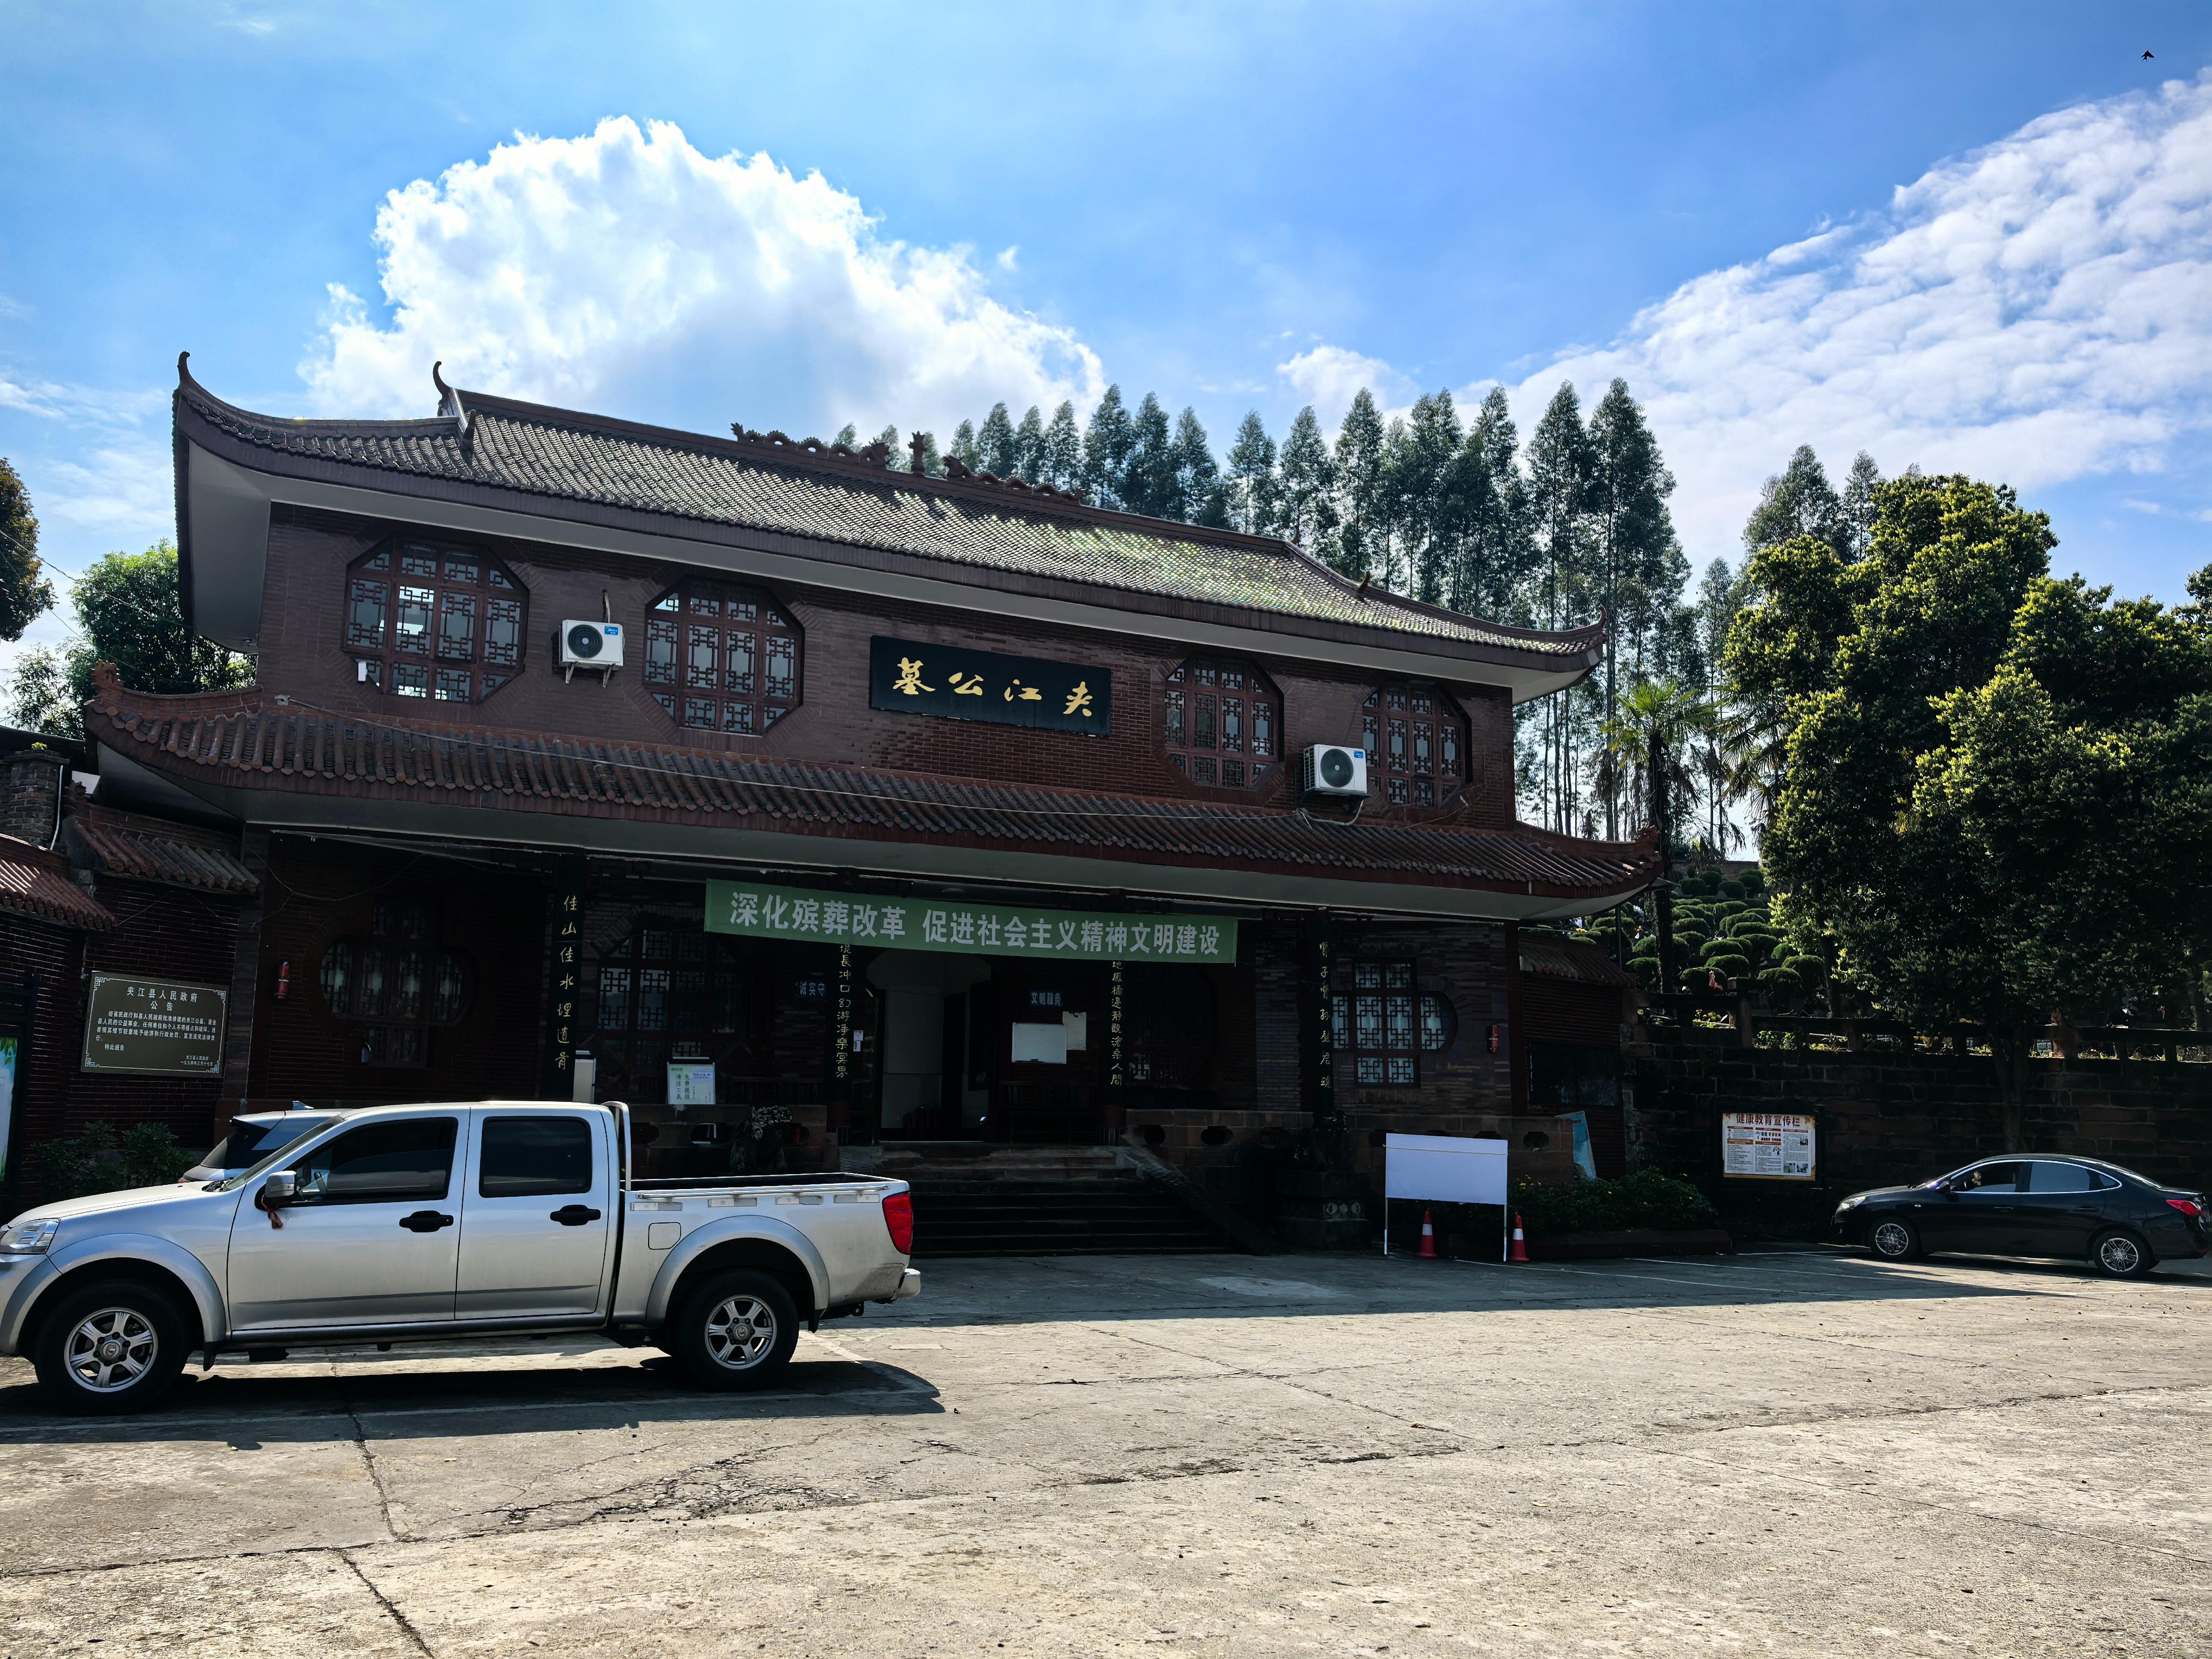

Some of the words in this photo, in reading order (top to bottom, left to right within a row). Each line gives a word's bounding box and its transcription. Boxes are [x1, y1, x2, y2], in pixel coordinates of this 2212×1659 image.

[730, 892, 906, 940] 深化殡葬改革
[922, 908, 1220, 955] 促进社会主义精神文明建设
[126, 986, 198, 1003] 夹江县人民政府
[1030, 990, 1062, 1006] 文明服务
[150, 1000, 173, 1011] 公告
[1736, 1112, 1800, 1127] 健康教育宣传栏
